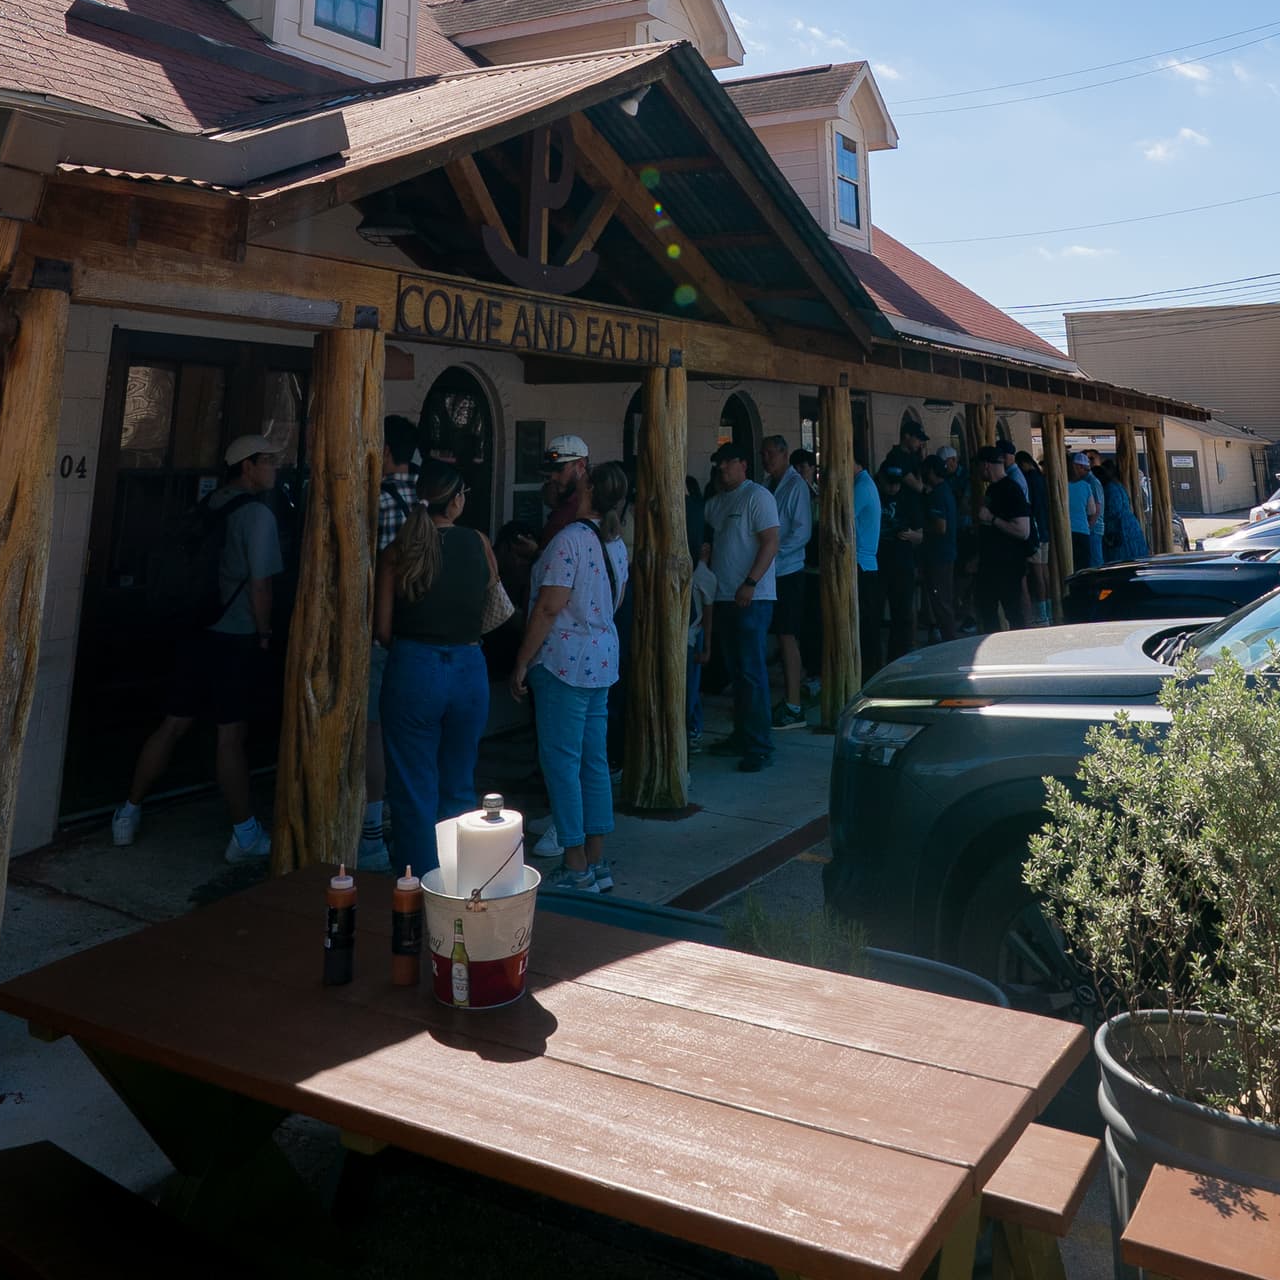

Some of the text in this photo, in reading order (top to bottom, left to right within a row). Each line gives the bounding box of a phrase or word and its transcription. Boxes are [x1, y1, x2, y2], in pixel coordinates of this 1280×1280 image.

[398, 284, 503, 344] COME
[510, 303, 578, 353] AND
[586, 316, 631, 361] EAT
